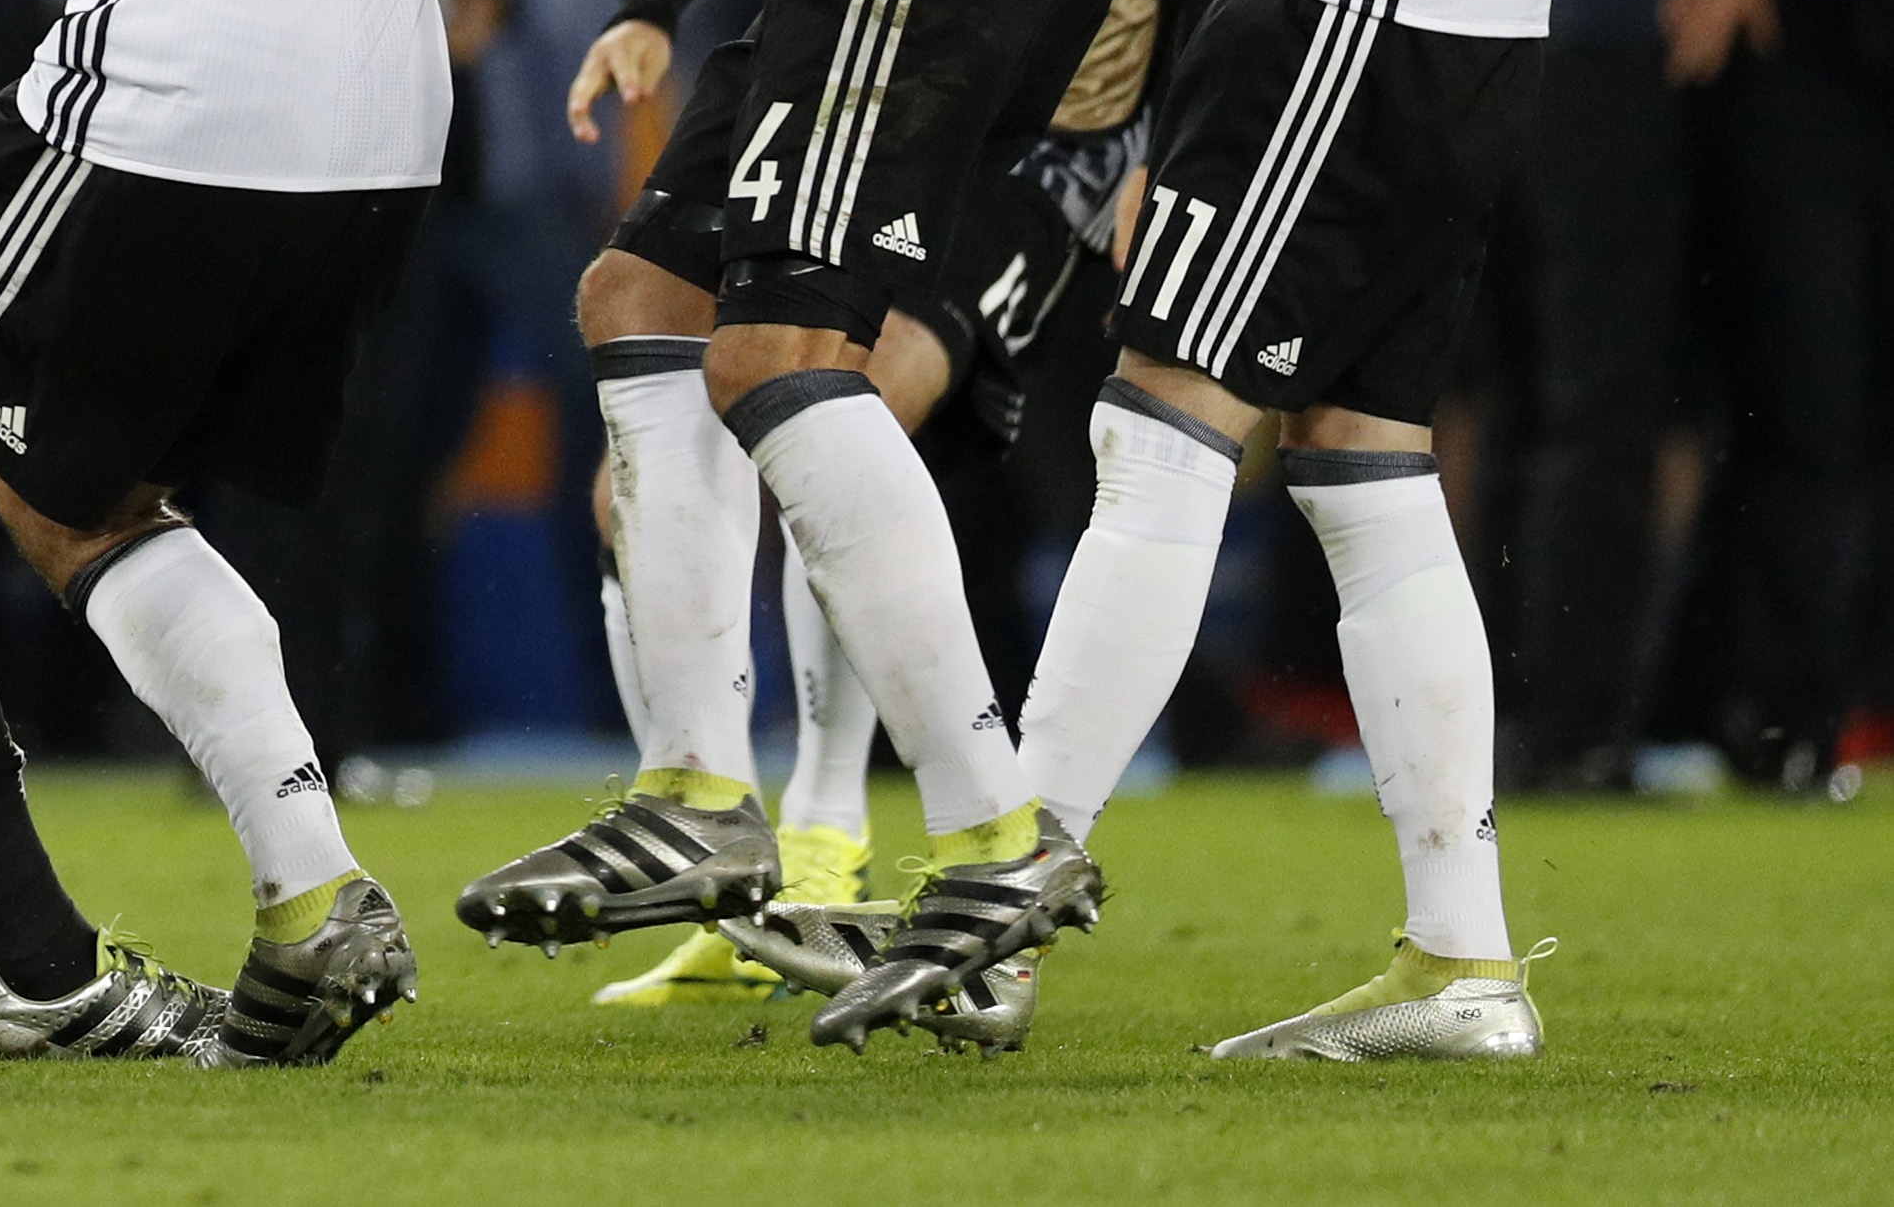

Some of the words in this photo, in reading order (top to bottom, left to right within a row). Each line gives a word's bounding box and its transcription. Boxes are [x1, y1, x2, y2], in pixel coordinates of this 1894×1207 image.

[727, 101, 794, 222] 4
[872, 233, 927, 261] adidas
[1119, 184, 1217, 321] 11
[1257, 350, 1297, 376] adidas
